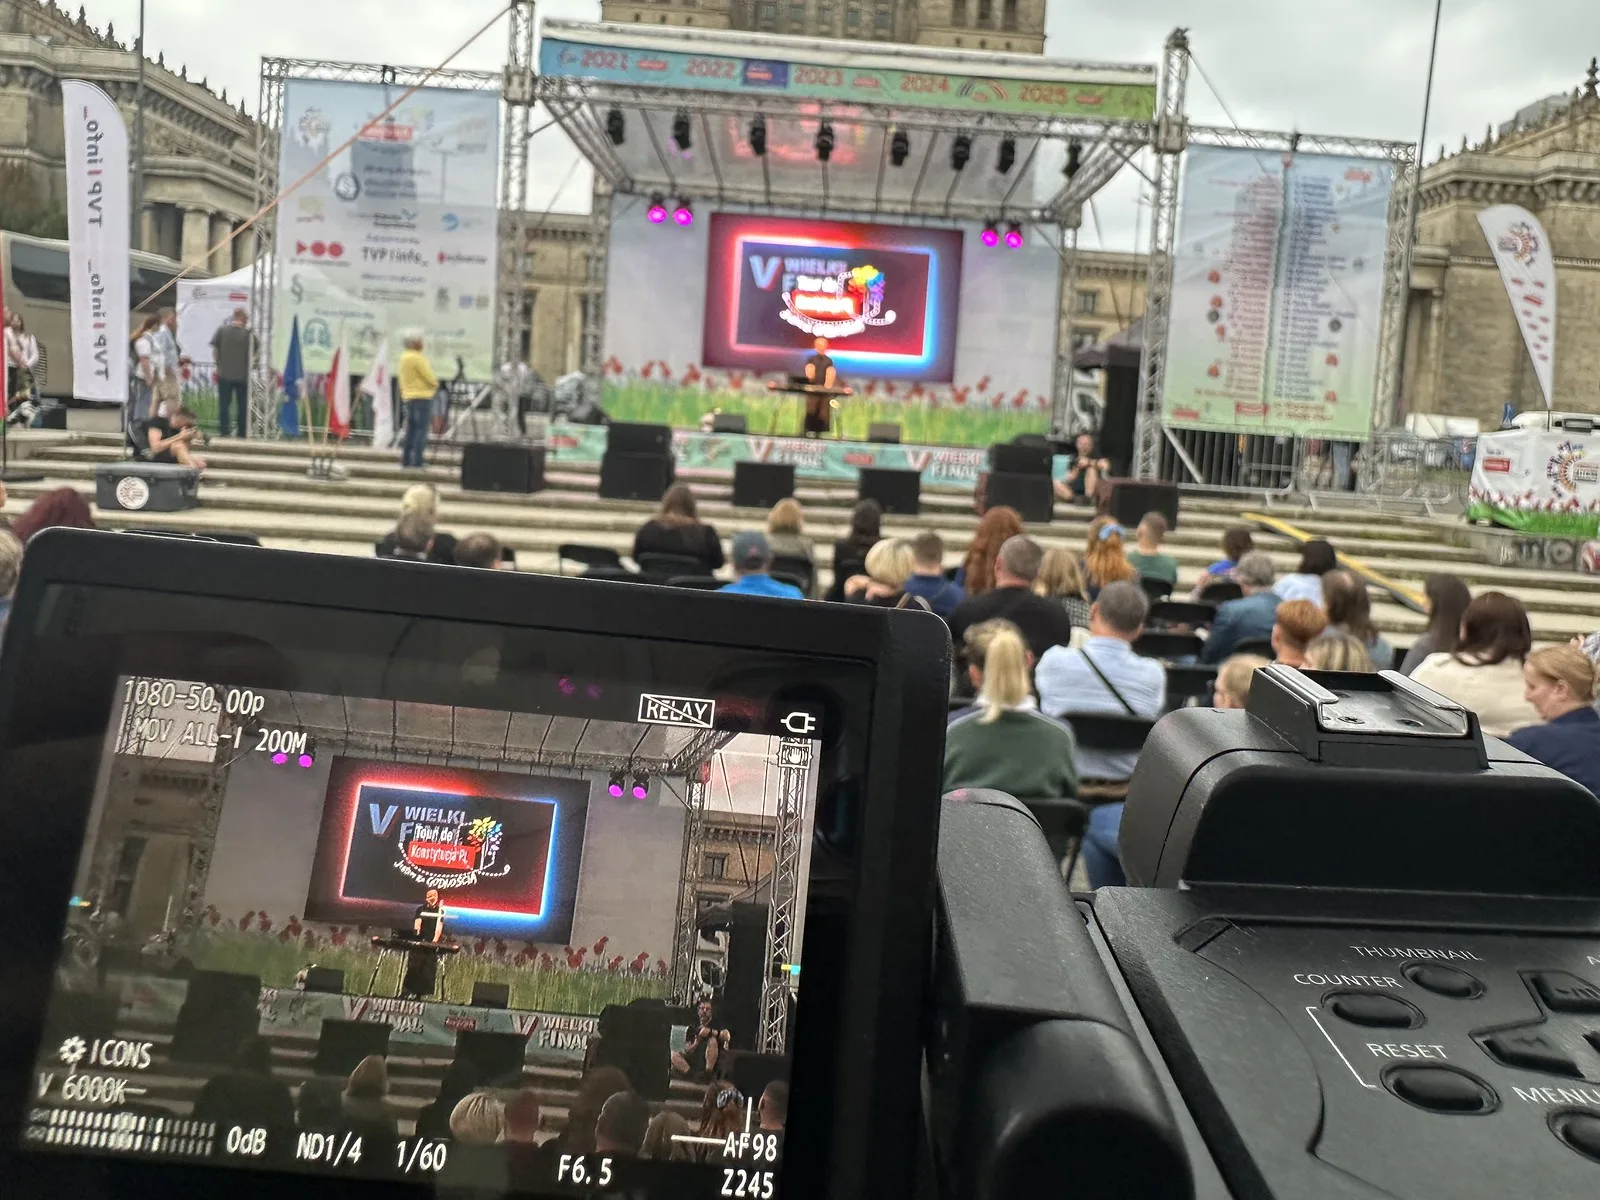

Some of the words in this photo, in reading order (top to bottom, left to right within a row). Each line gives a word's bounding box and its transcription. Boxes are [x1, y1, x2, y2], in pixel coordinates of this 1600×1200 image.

[581, 49, 628, 71] 2021
[684, 58, 736, 80] 2022
[795, 67, 844, 87] 2023
[900, 72, 948, 93] 2024
[1018, 83, 1069, 106] 2025
[749, 255, 782, 291] V
[646, 699, 708, 723] RELAY
[255, 728, 307, 754] 200M
[370, 803, 399, 836] V
[405, 806, 466, 825] WIELKI
[1350, 946, 1484, 962] THUMBNAIL
[1293, 973, 1404, 989] COUNTER
[510, 1015, 539, 1036] V
[542, 1016, 595, 1033] WIELKI
[88, 1039, 153, 1070] ICONS
[538, 1030, 588, 1051] FINAL
[1366, 1042, 1449, 1060] RESET
[61, 1074, 128, 1106] 6000K
[1511, 1086, 1600, 1105] MENU
[226, 1125, 268, 1155] 0dB
[296, 1131, 363, 1168] ND1/4
[397, 1137, 448, 1174] 1/60
[722, 1131, 778, 1163] AF98
[720, 1167, 776, 1200] Z245
